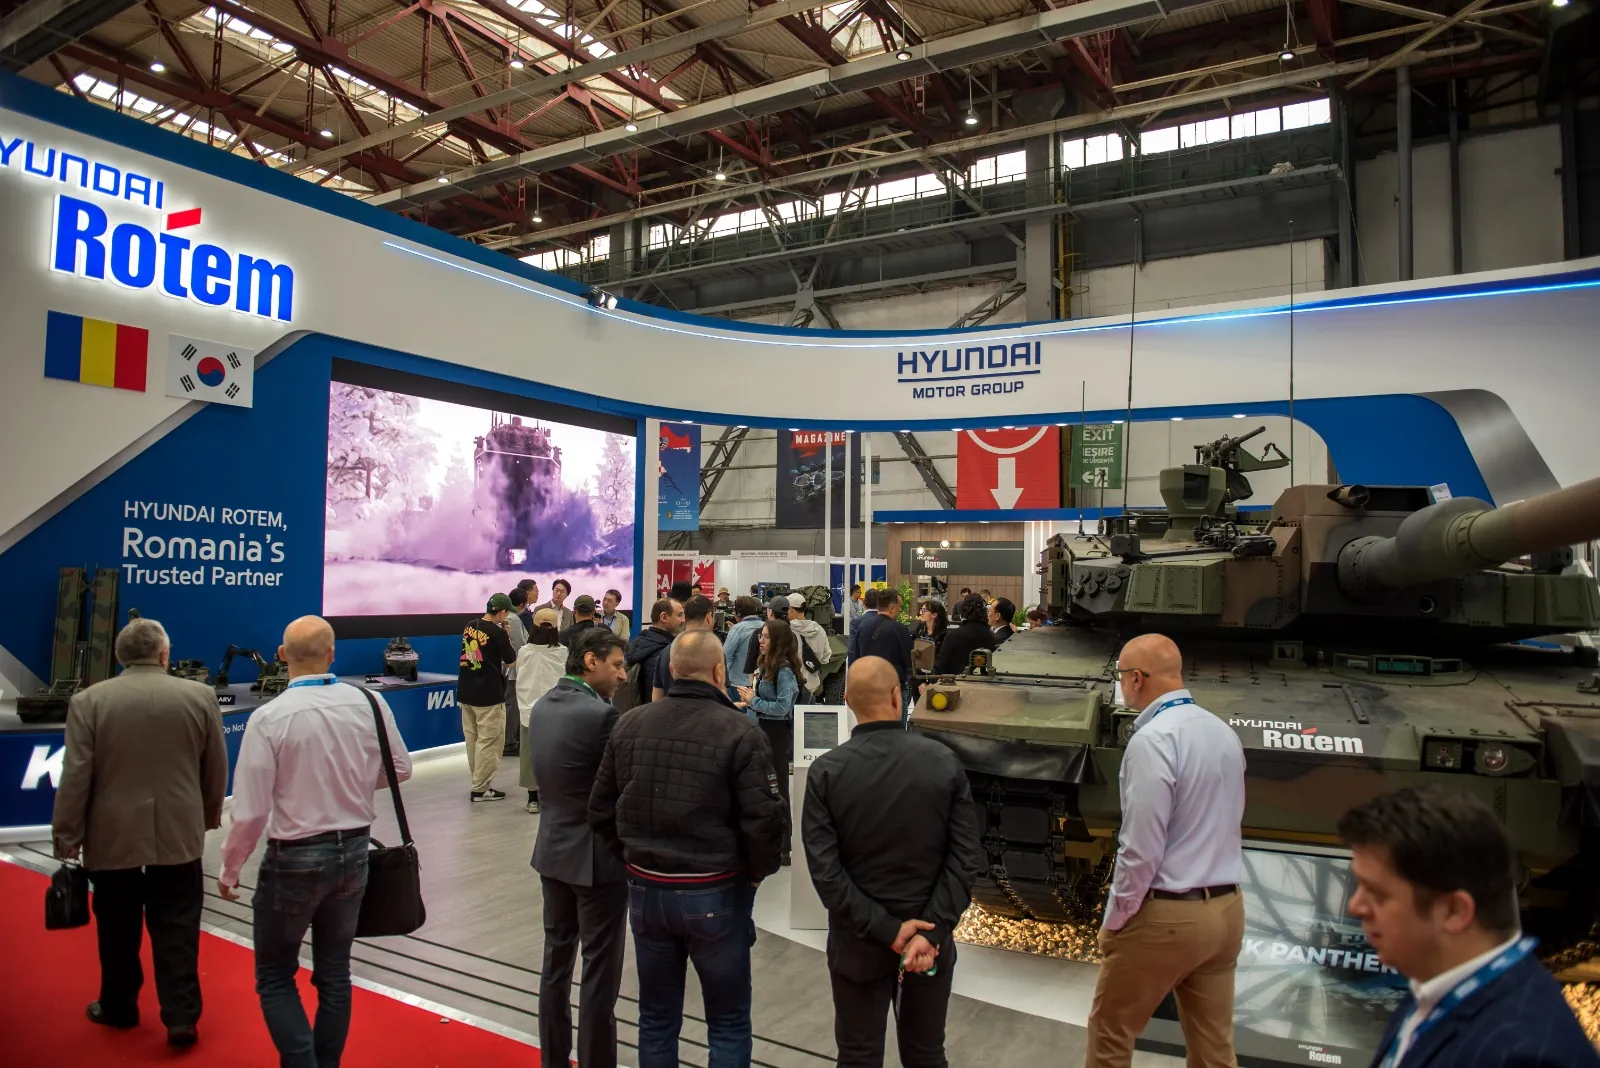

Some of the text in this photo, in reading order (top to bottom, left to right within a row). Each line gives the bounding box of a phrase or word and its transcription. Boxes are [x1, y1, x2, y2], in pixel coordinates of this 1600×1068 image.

[55, 195, 294, 322] Rotem
[897, 341, 1041, 375] HYUNDAI
[912, 381, 1024, 399] MOTOR GROUP
[1083, 428, 1115, 441] EXIT
[124, 500, 288, 531] HYUNDAI ROTEM,
[122, 527, 285, 563] Romania's
[122, 563, 284, 587] Trusted Partner
[924, 560, 948, 569] Rotem
[427, 688, 461, 711] WA
[232, 723, 245, 733] Not
[1229, 718, 1302, 730] HYUNDAI
[1262, 728, 1363, 754] Rotem
[1308, 1050, 1342, 1065] Rotem
